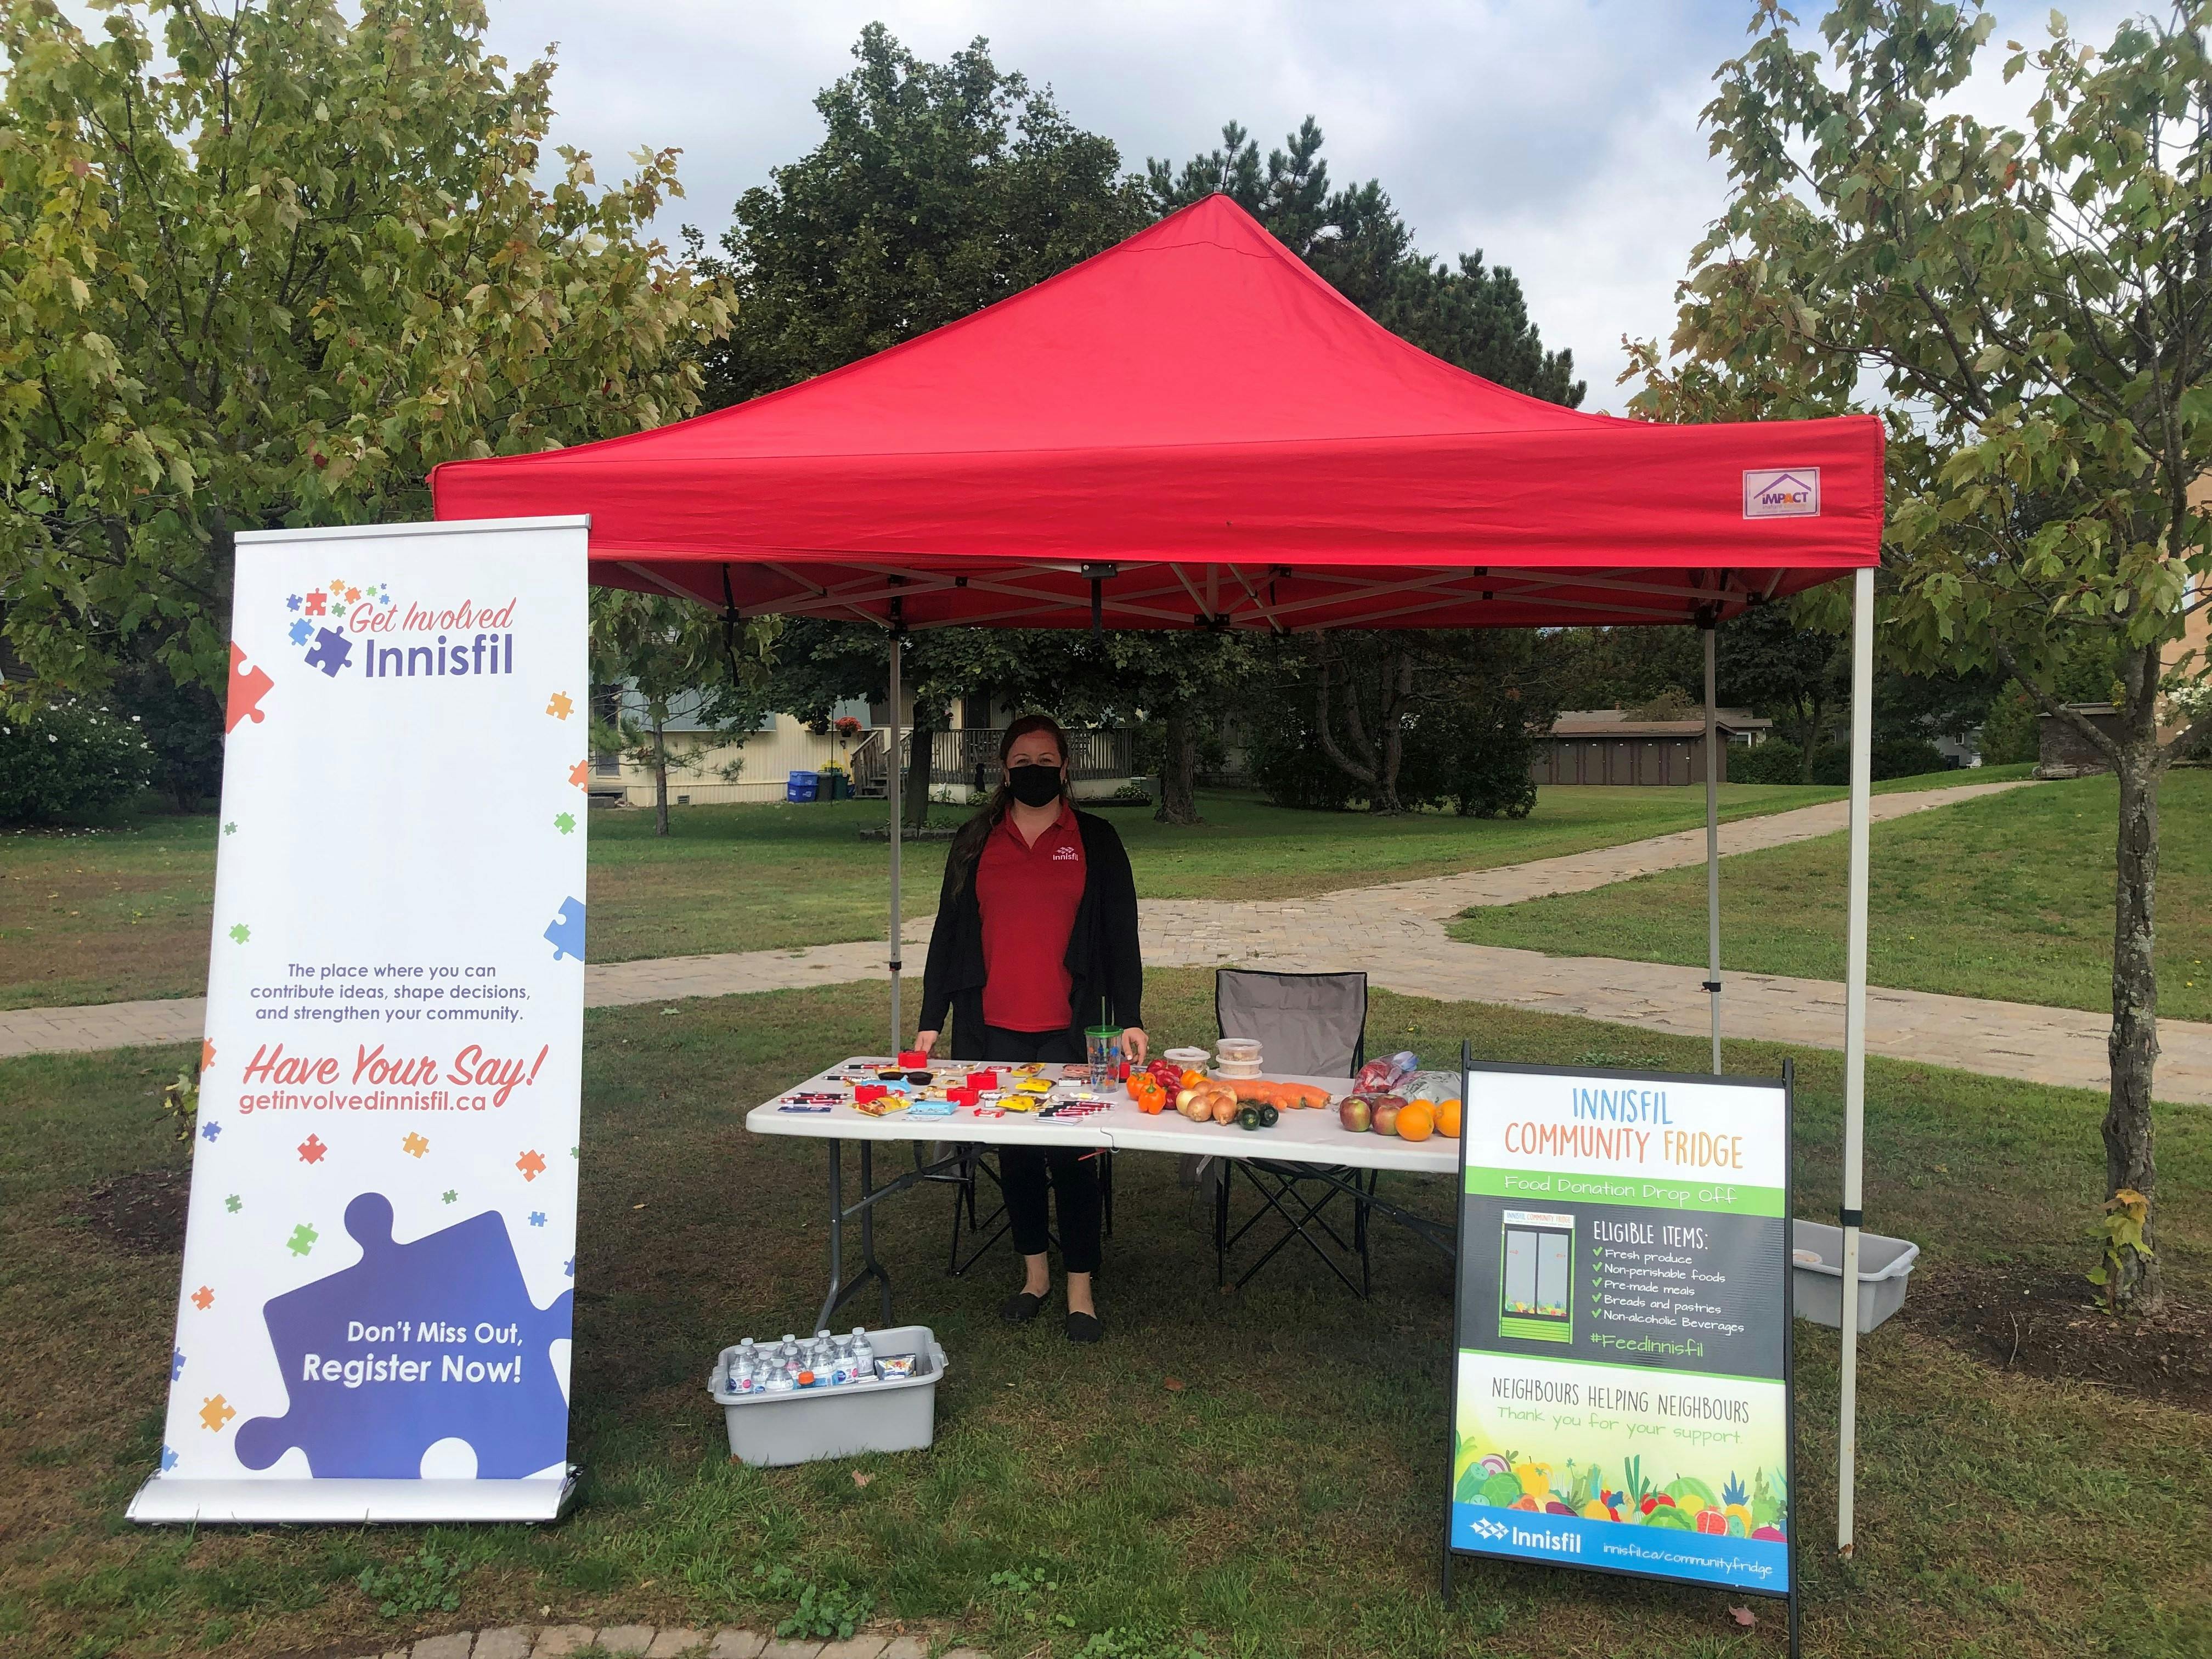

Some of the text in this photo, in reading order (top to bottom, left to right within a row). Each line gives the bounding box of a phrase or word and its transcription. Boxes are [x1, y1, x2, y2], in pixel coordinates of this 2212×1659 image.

[349, 596, 516, 633] Get Involved
[366, 634, 512, 678] Innisfil
[1053, 853, 1079, 861] Innisfil
[289, 963, 496, 980] The place where you can
[250, 985, 531, 1002] contribute ideas, shape decisions,
[255, 1006, 523, 1023] and strengthen your community.
[242, 1043, 549, 1108] Have Your Say!
[239, 1091, 487, 1114] getinvolvedinnisfil.ca
[1572, 1088, 1673, 1125] INNISFIL
[1505, 1121, 1744, 1169] COMMUNITY FRIDGE
[1504, 1175, 1738, 1208] Food Donation Drop Off
[1593, 1220, 1709, 1250] ELIGIBLE ITEMS:
[1605, 1249, 1692, 1265] Fresh produce
[1604, 1263, 1726, 1283] Non-perishable foods
[1604, 1279, 1695, 1296] Pre-made meals
[1604, 1294, 1722, 1314] Breads and pastries
[347, 1321, 523, 1346] Don’t Miss Out,
[1604, 1309, 1745, 1336] Non-alcoholic Beverages
[1590, 1333, 1703, 1357] #FeedInnisfil
[303, 1353, 522, 1389] Register Now!
[1492, 1376, 1749, 1424] NEIGHBOURS HELPING NEIGHBOURS
[1497, 1406, 1742, 1447] Thank you for your support.
[1512, 1526, 1774, 1579] Innisfil innisfil.ca/communityfridge
